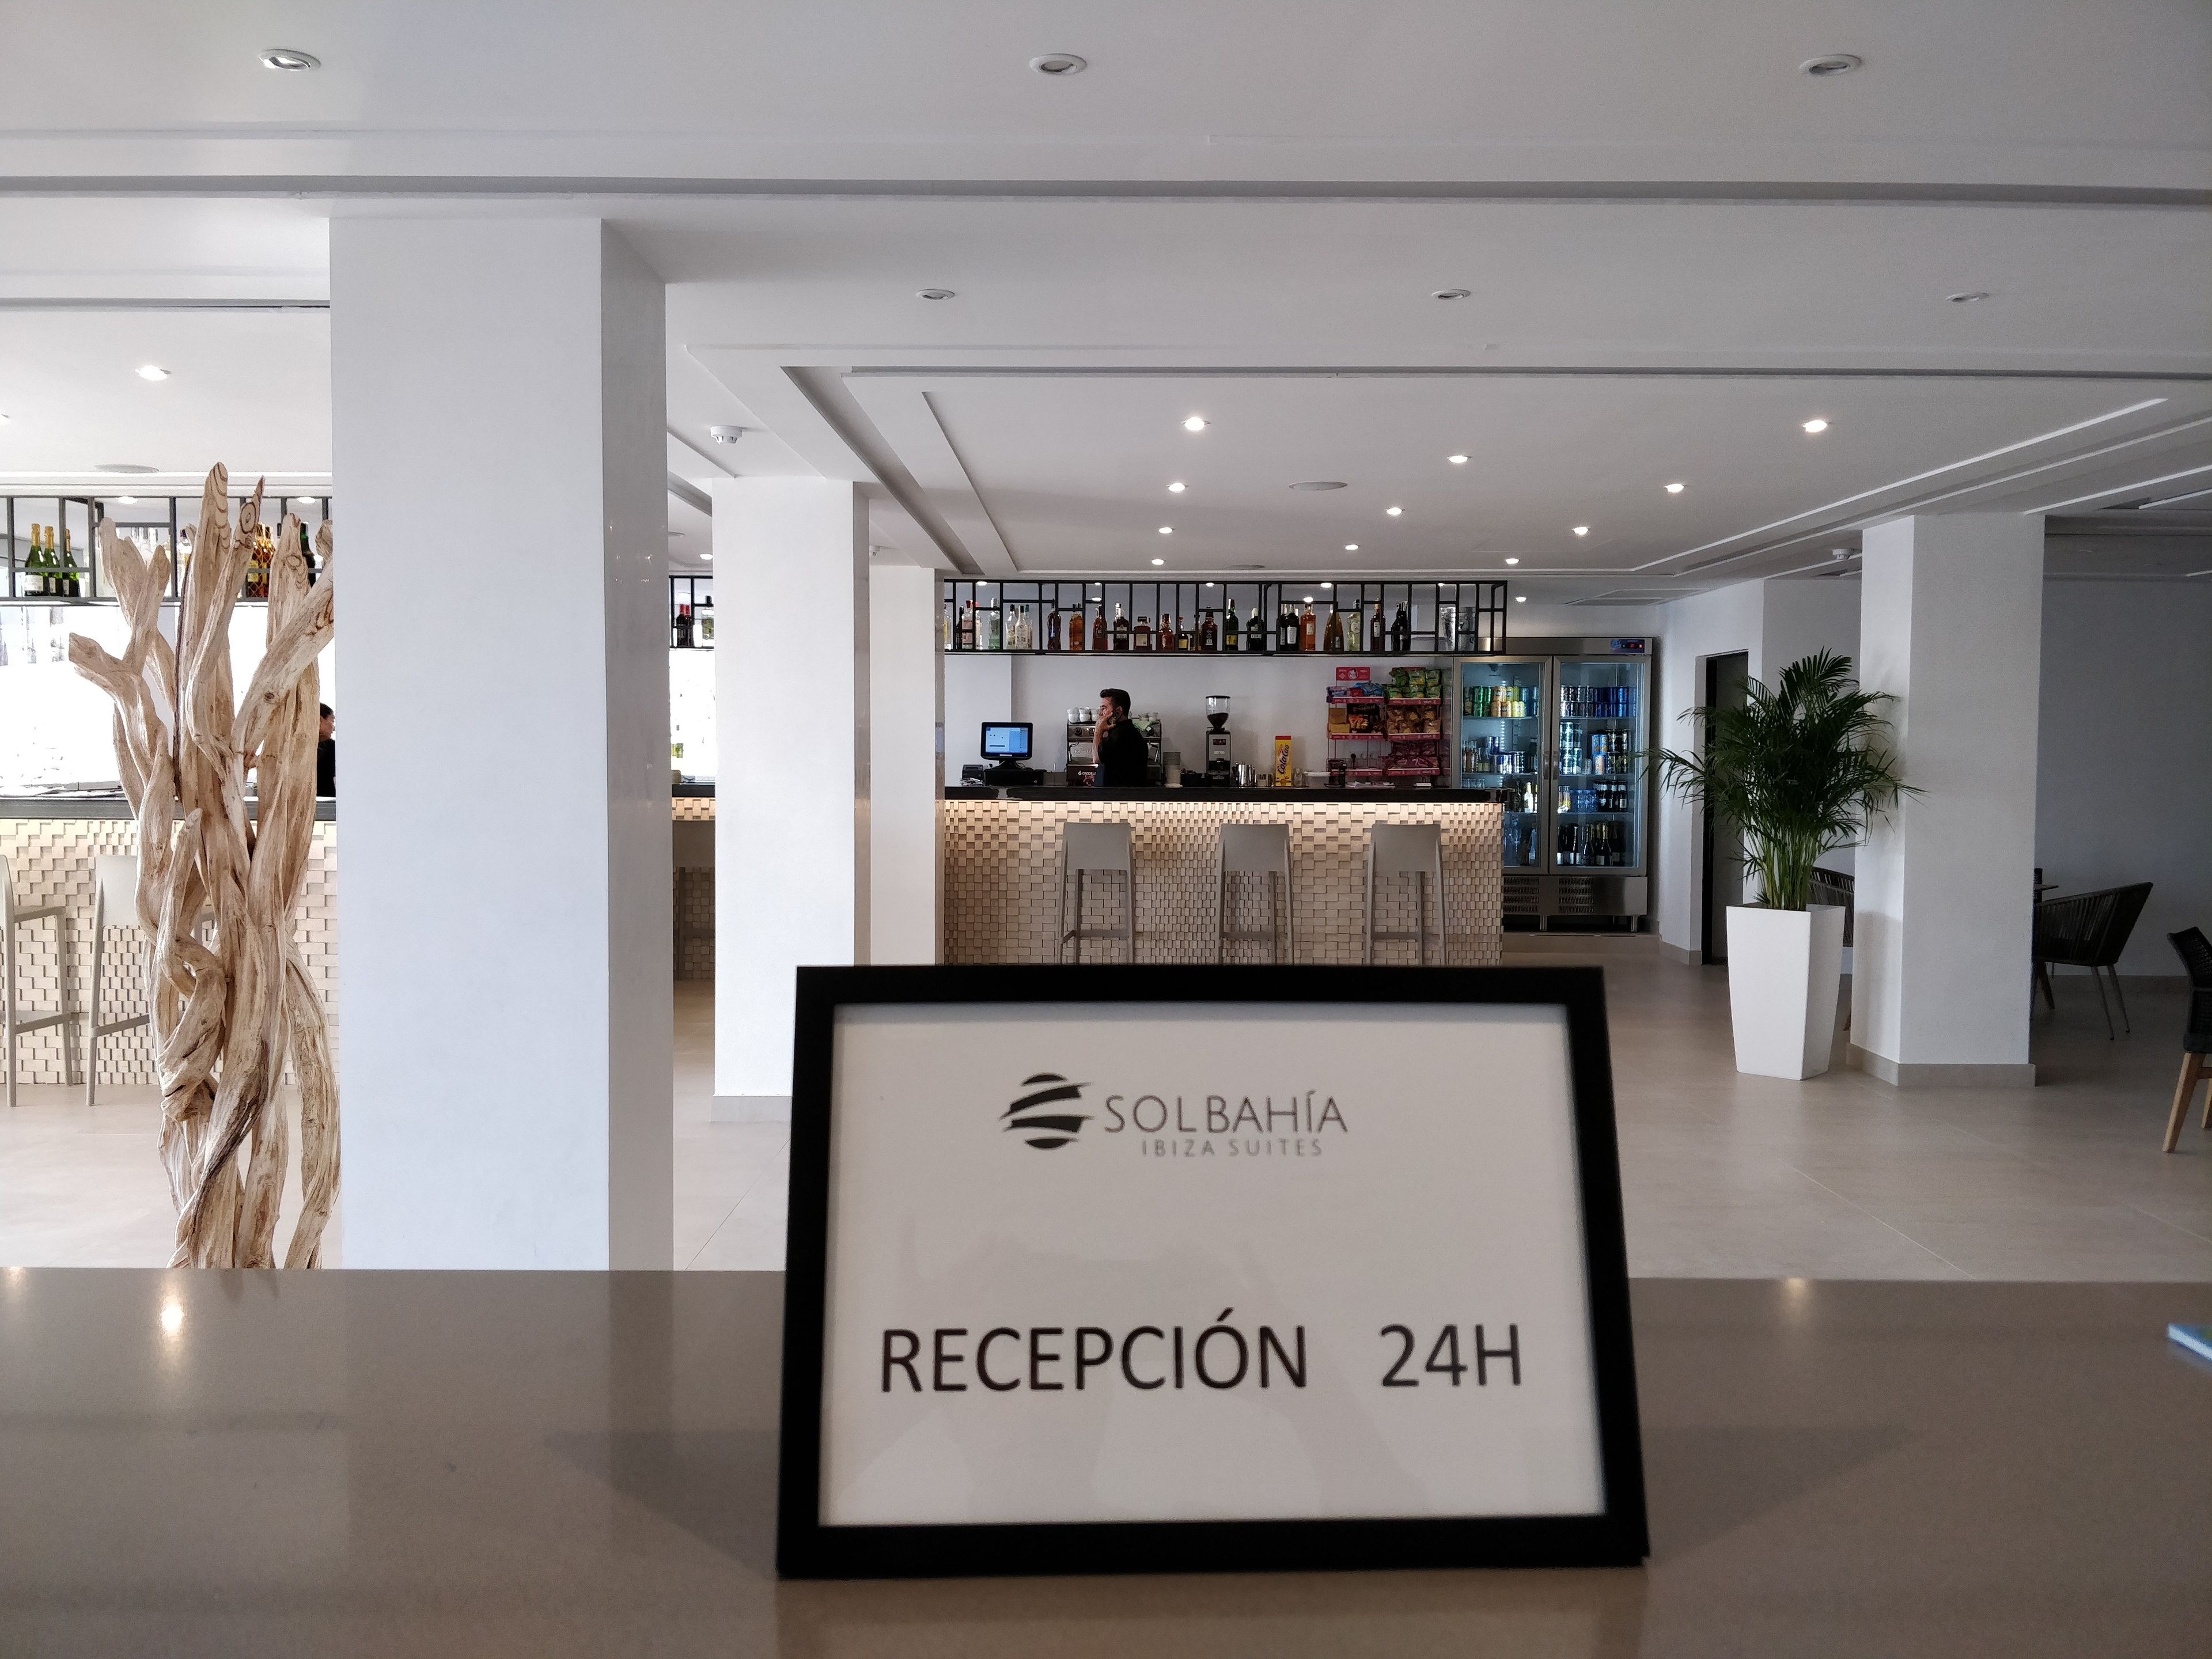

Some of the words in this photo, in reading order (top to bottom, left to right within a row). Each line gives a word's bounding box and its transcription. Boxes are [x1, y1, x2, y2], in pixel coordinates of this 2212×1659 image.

[1104, 1089, 1348, 1134] SOLBAHÍA
[1142, 1138, 1215, 1157] IBIZA
[1228, 1138, 1323, 1157] SUITES
[881, 1307, 1307, 1392] RECEPCIÓN
[1380, 1323, 1522, 1387] 24H
